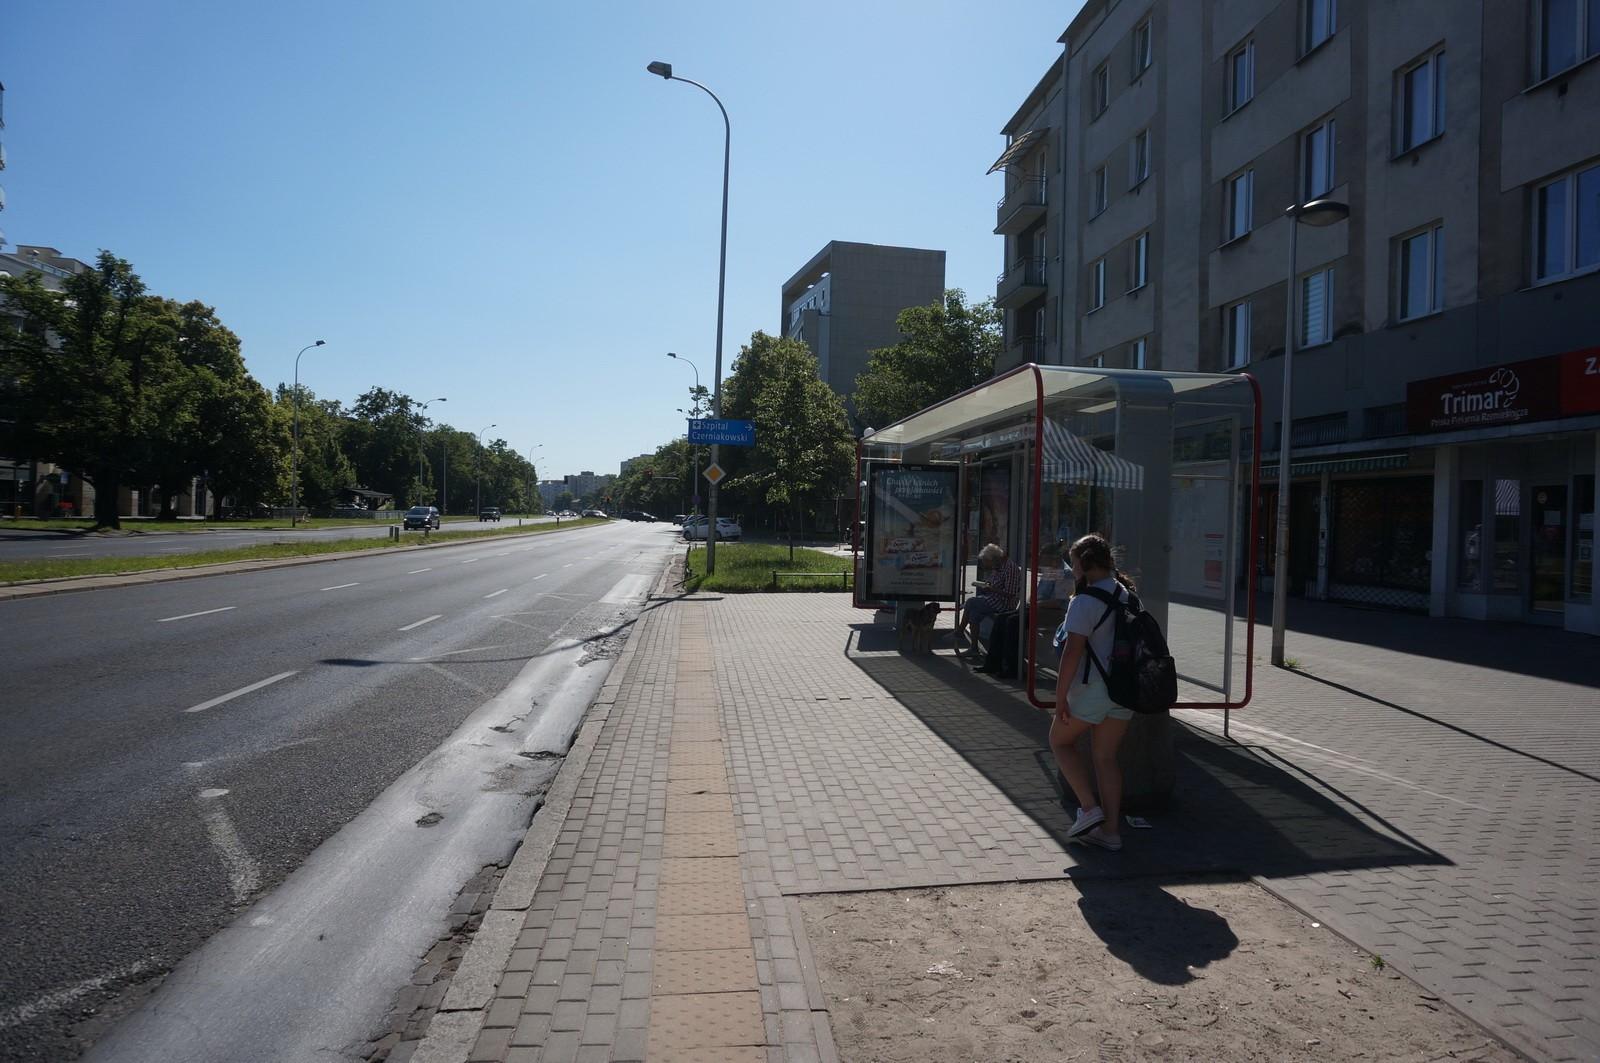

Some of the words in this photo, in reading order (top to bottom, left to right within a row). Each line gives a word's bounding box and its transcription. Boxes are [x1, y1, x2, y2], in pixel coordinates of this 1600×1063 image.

[1585, 356, 1600, 375] Z
[1441, 390, 1503, 415] Trimar
[702, 421, 728, 430] Szpital
[692, 431, 748, 441] Czerniakowski
